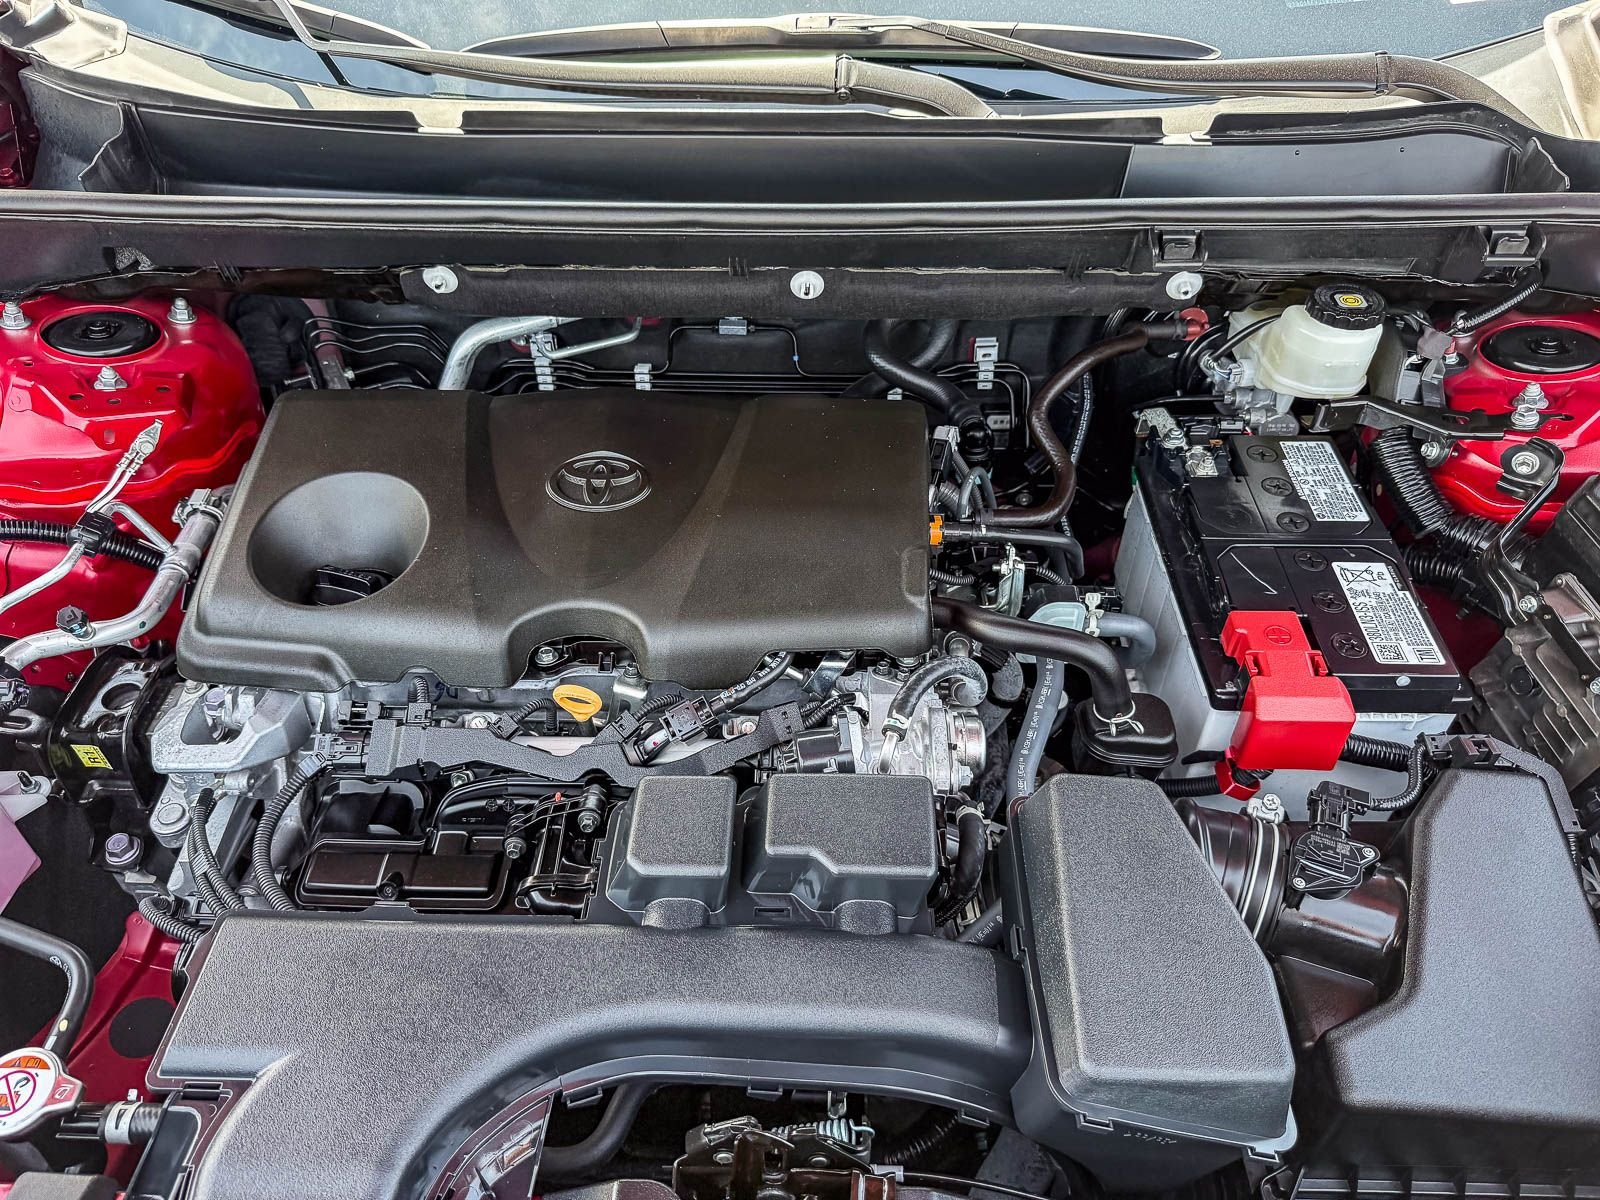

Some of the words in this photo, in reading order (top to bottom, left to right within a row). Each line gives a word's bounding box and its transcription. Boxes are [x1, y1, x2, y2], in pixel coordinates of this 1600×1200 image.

[1376, 571, 1387, 581] Pb
[1352, 602, 1384, 641] 380LN3-ISS
[83, 751, 102, 763] R1
